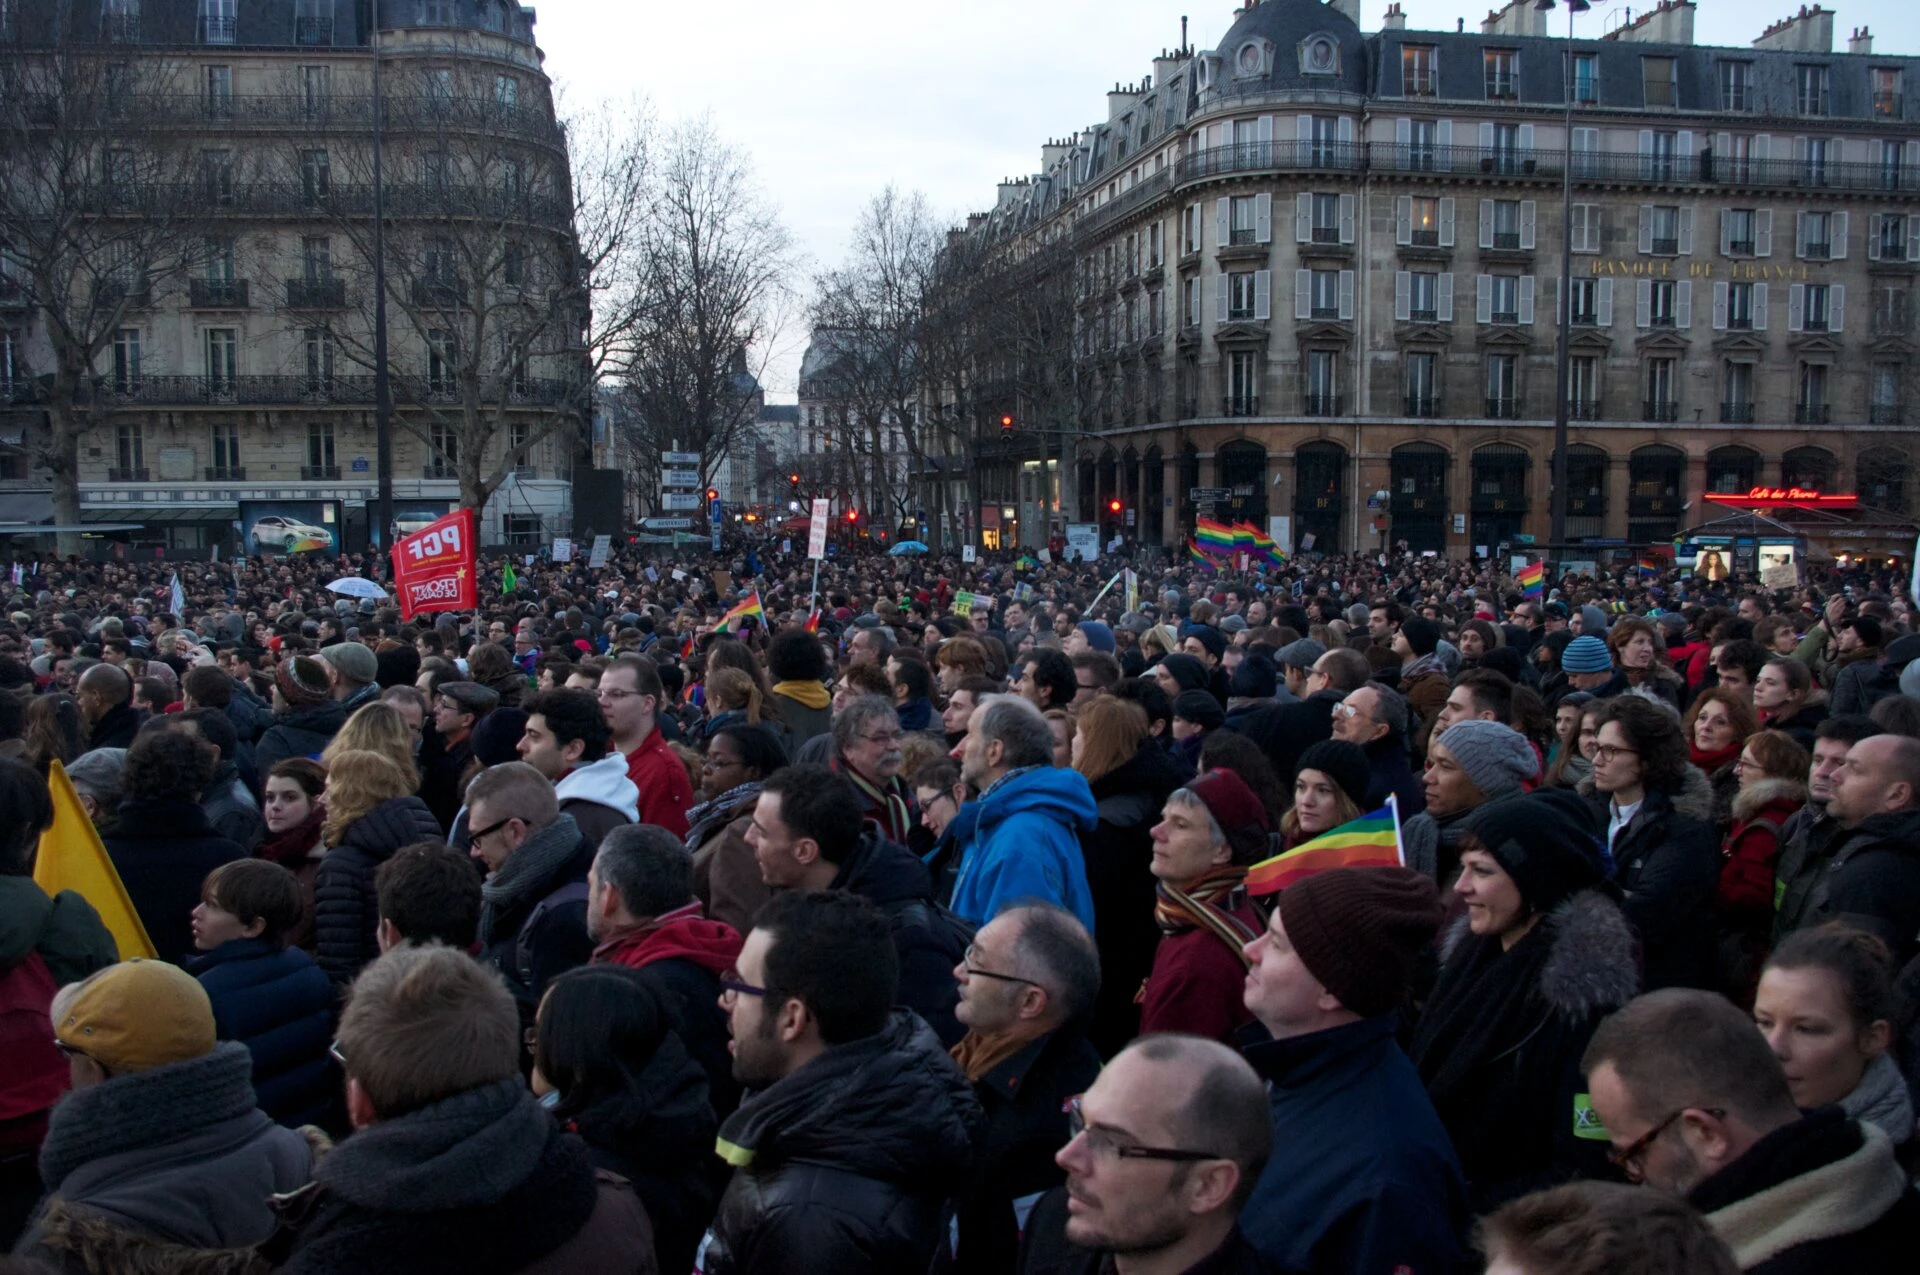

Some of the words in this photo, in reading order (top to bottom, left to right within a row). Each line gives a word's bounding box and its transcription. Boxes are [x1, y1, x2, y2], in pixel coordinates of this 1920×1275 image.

[1592, 260, 1669, 276] BANQUE
[1690, 263, 1713, 276] DE
[1732, 263, 1809, 280] FRANCE
[1316, 498, 1329, 508] BF
[1413, 498, 1426, 509] BF
[1494, 499, 1508, 509] BF
[1573, 499, 1585, 509] BF
